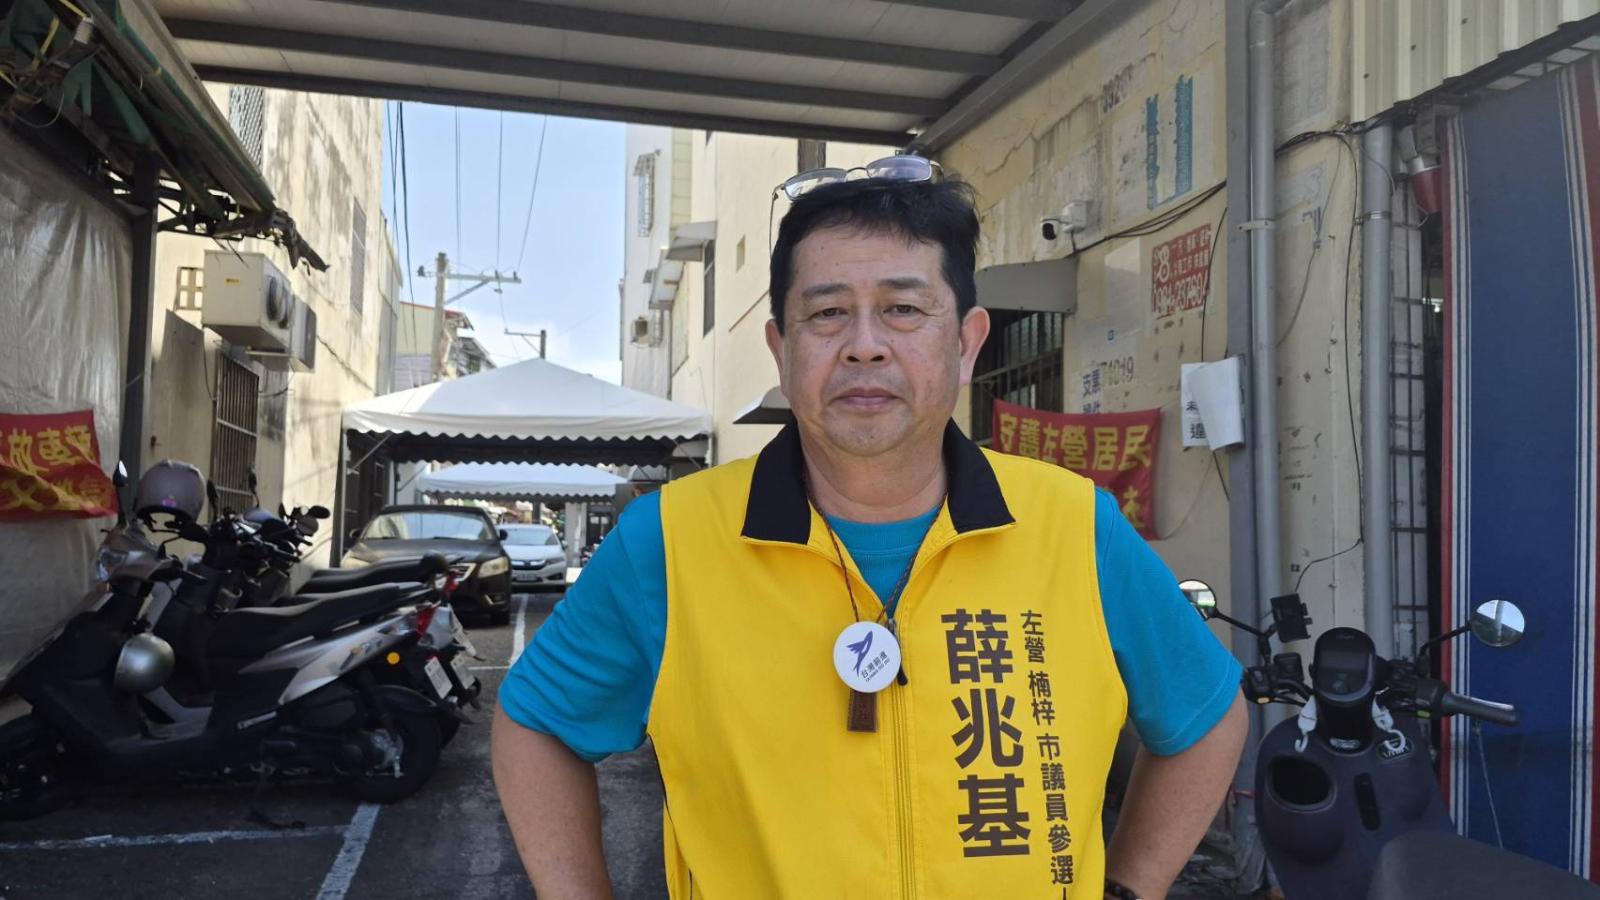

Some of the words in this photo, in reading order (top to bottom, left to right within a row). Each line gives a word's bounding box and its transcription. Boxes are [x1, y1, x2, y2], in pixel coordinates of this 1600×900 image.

[1020, 610, 1045, 664] 左營
[1028, 670, 1055, 726] 楠梓
[941, 608, 1031, 858] 薛兆基
